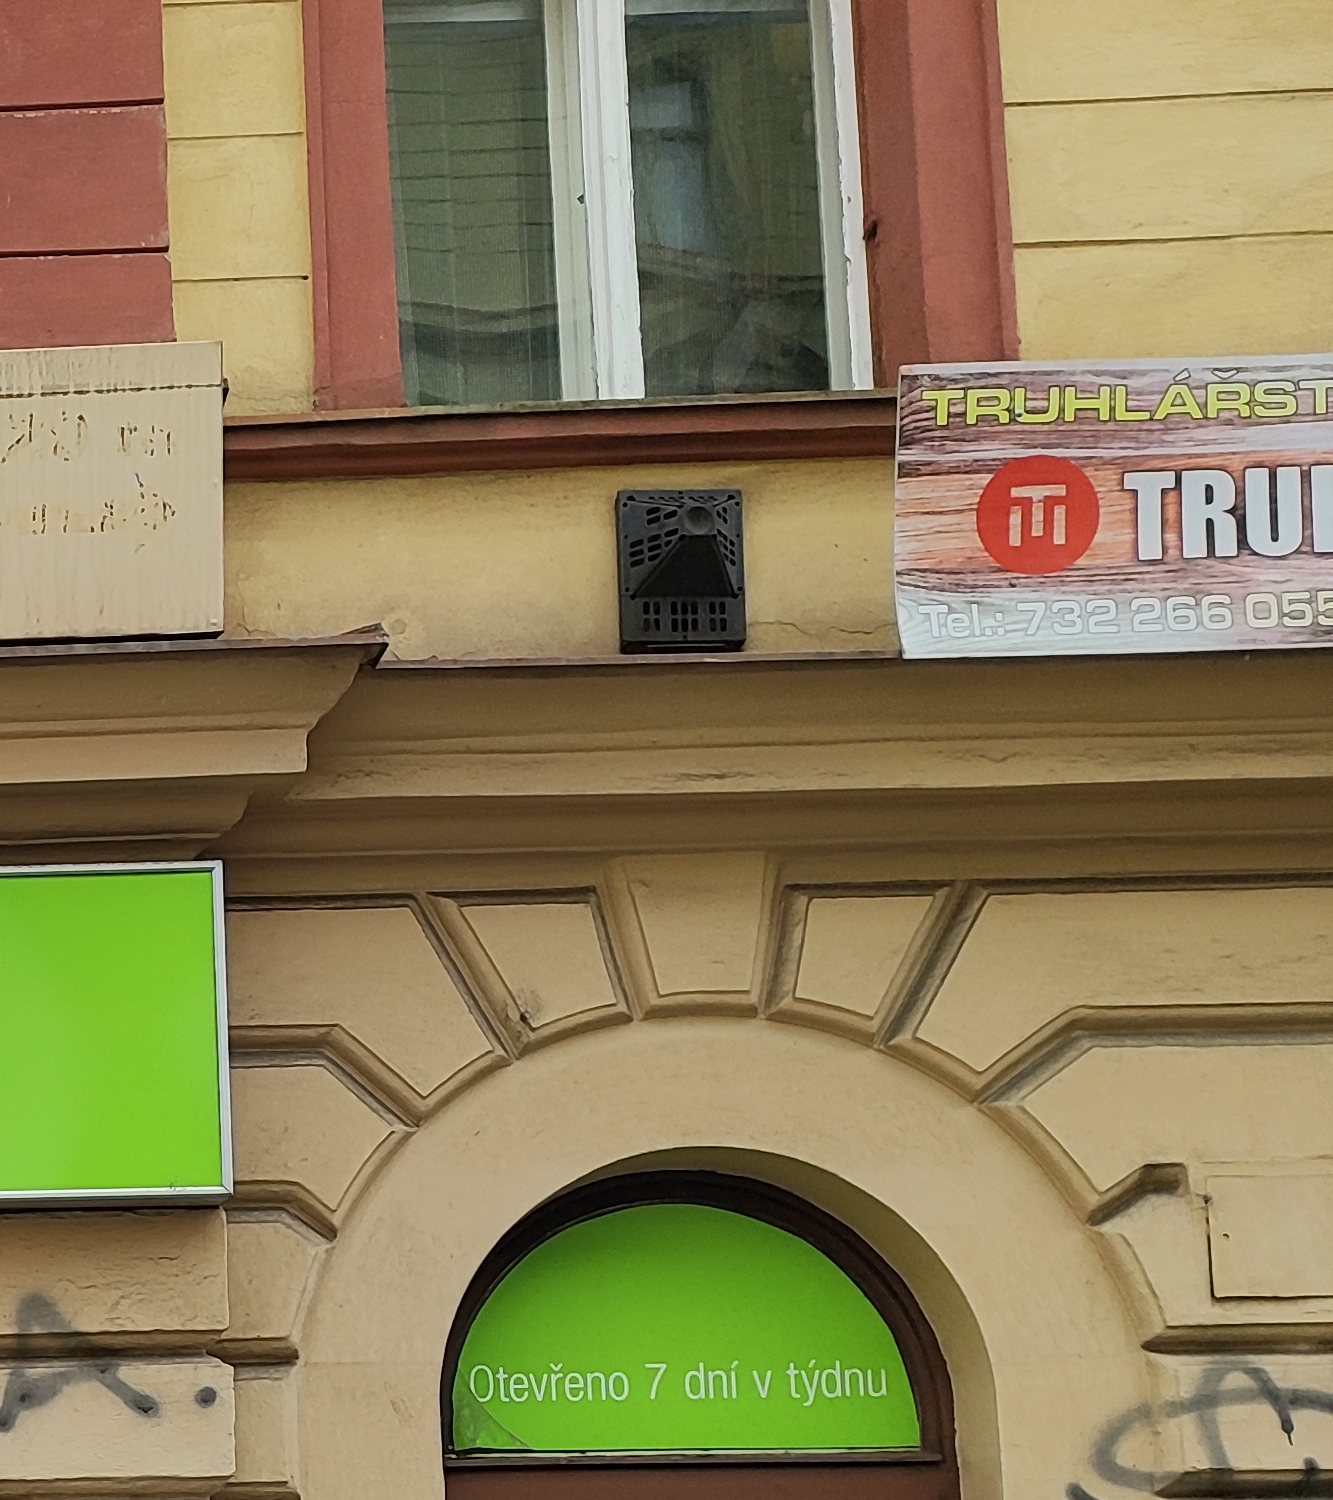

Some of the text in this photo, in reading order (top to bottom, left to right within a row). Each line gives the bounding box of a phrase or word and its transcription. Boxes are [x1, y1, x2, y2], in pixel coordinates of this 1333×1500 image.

[921, 368, 1333, 426] TRUHLÁŘST
[919, 590, 1333, 638] Tel.: 732 266 055
[469, 1359, 888, 1407] Otevřeno 7 dní v týdnu
